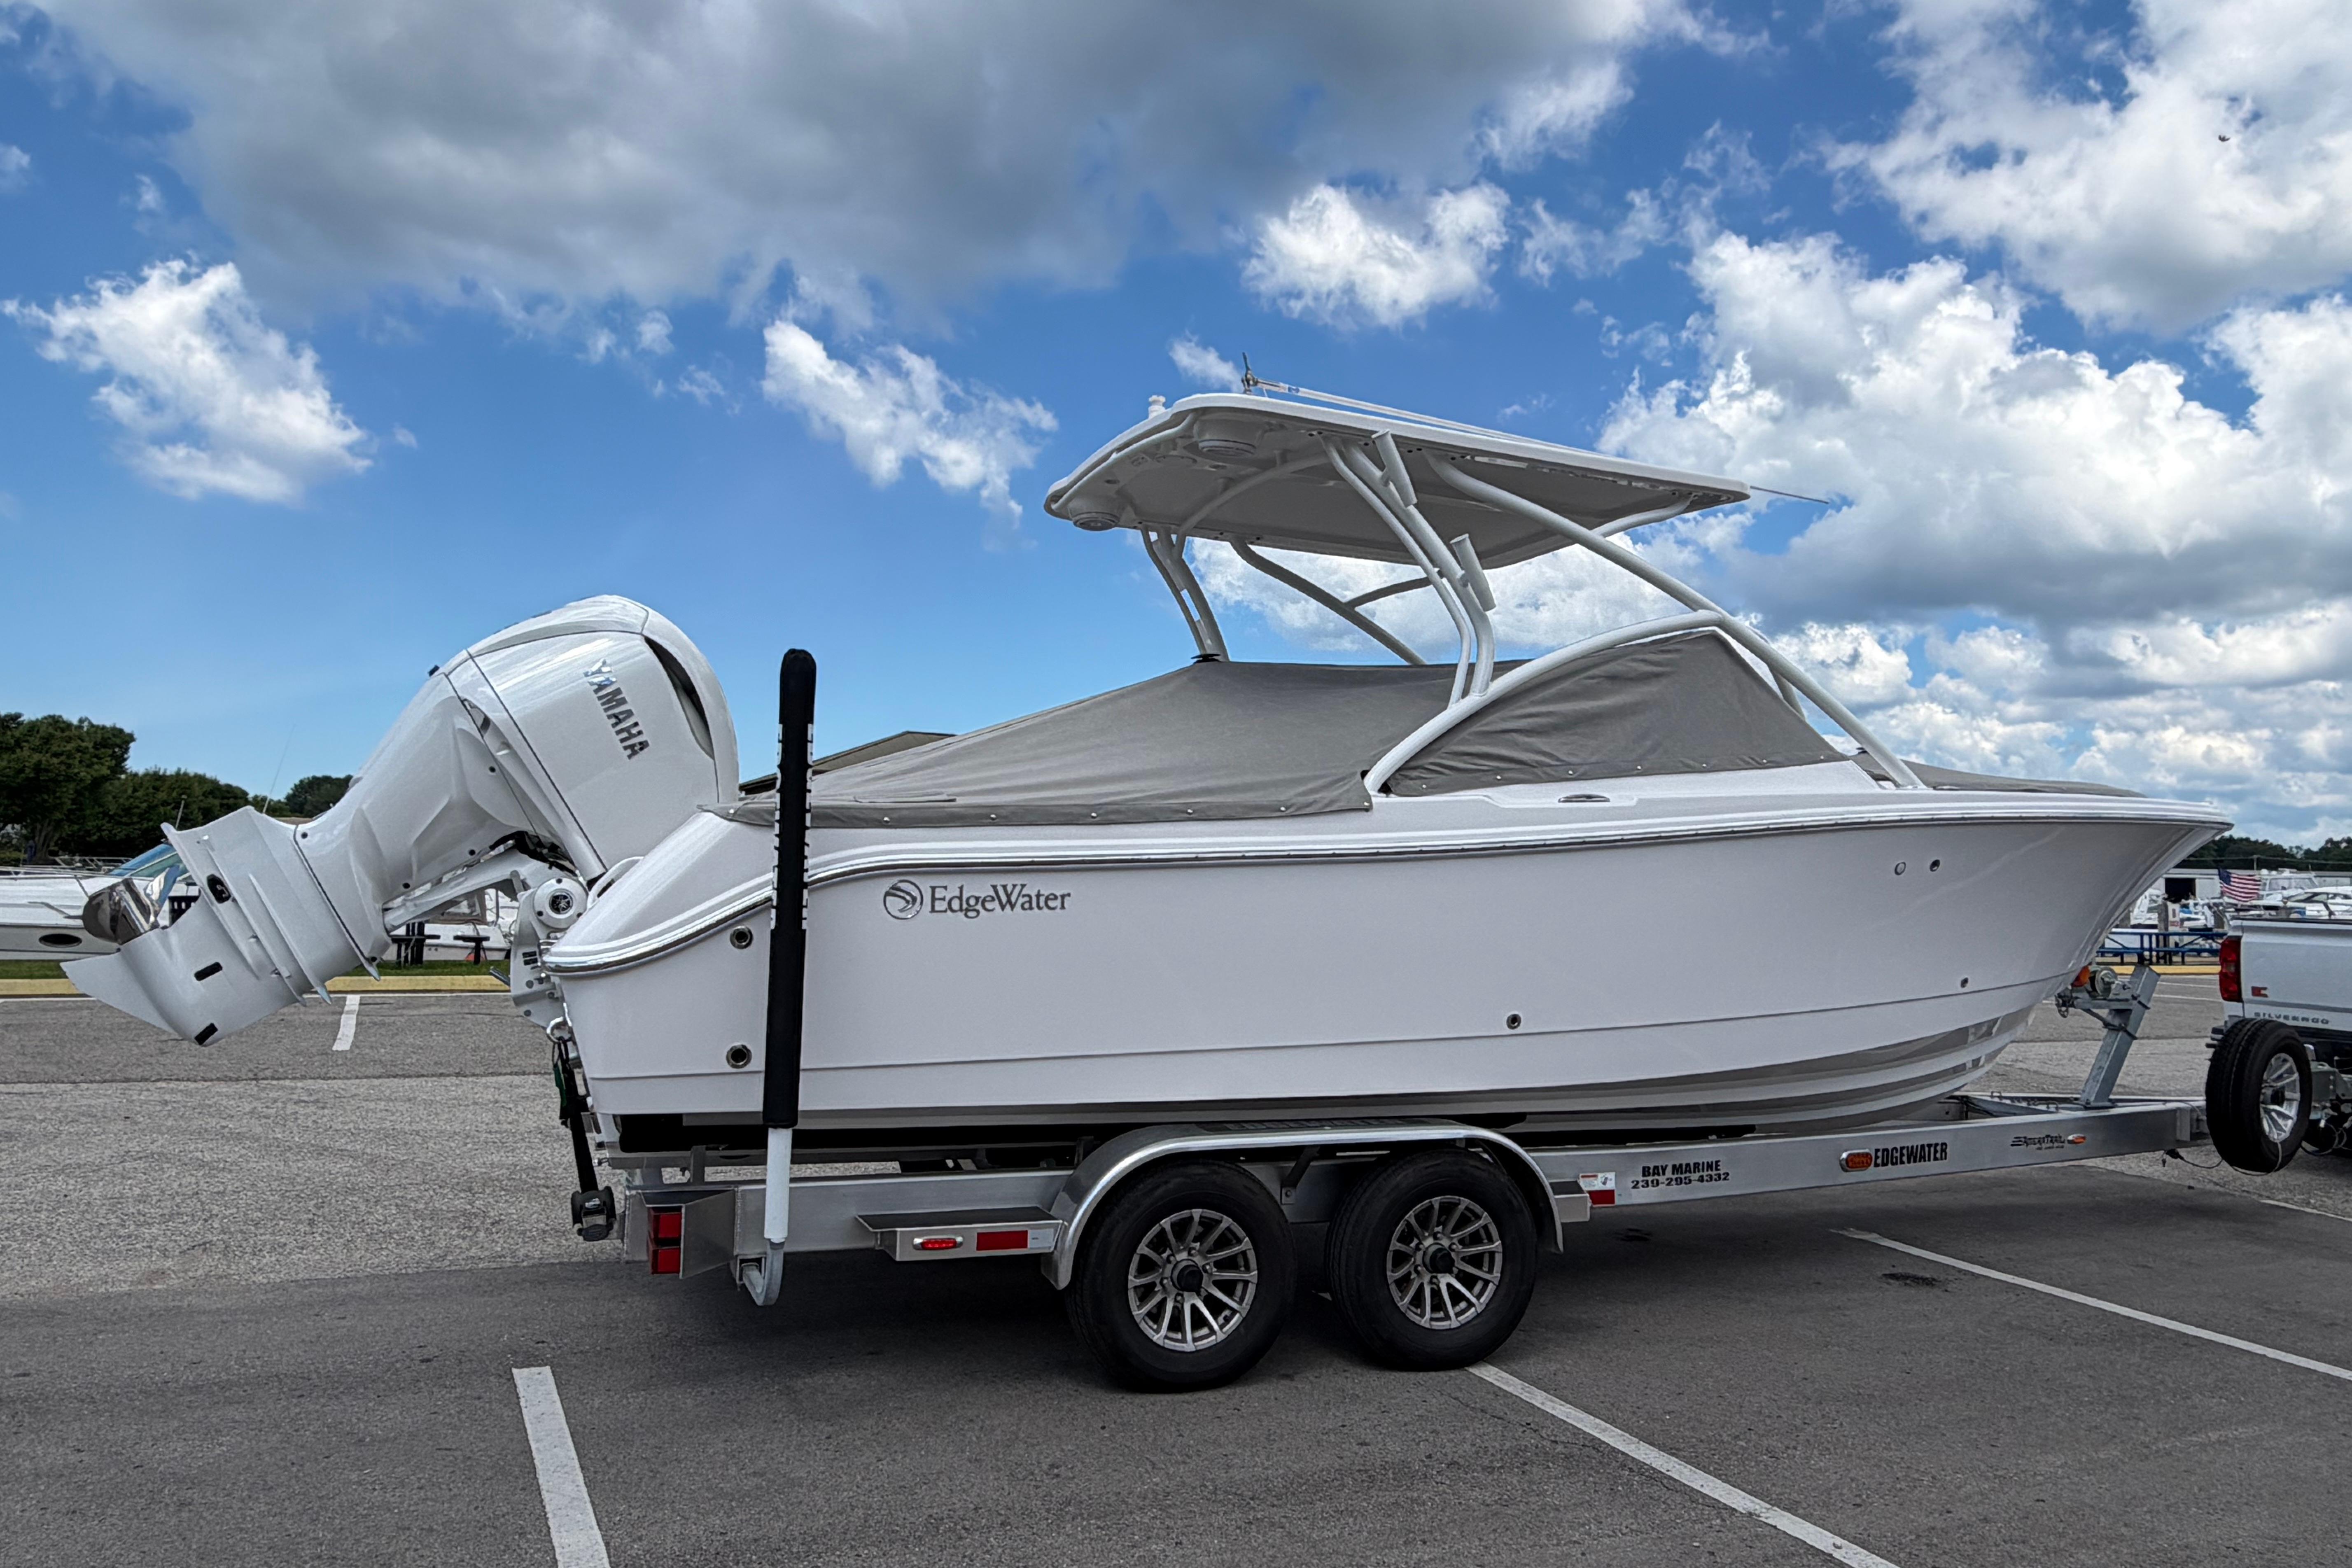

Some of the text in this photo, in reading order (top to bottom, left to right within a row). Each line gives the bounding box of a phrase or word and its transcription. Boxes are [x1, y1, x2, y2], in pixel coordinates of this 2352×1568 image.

[583, 658, 649, 760] YAMAHA
[929, 884, 1071, 919] EdgeWater
[1642, 1160, 1721, 1177] BAY MARINE
[1874, 1142, 1948, 1167] EDGEWATER
